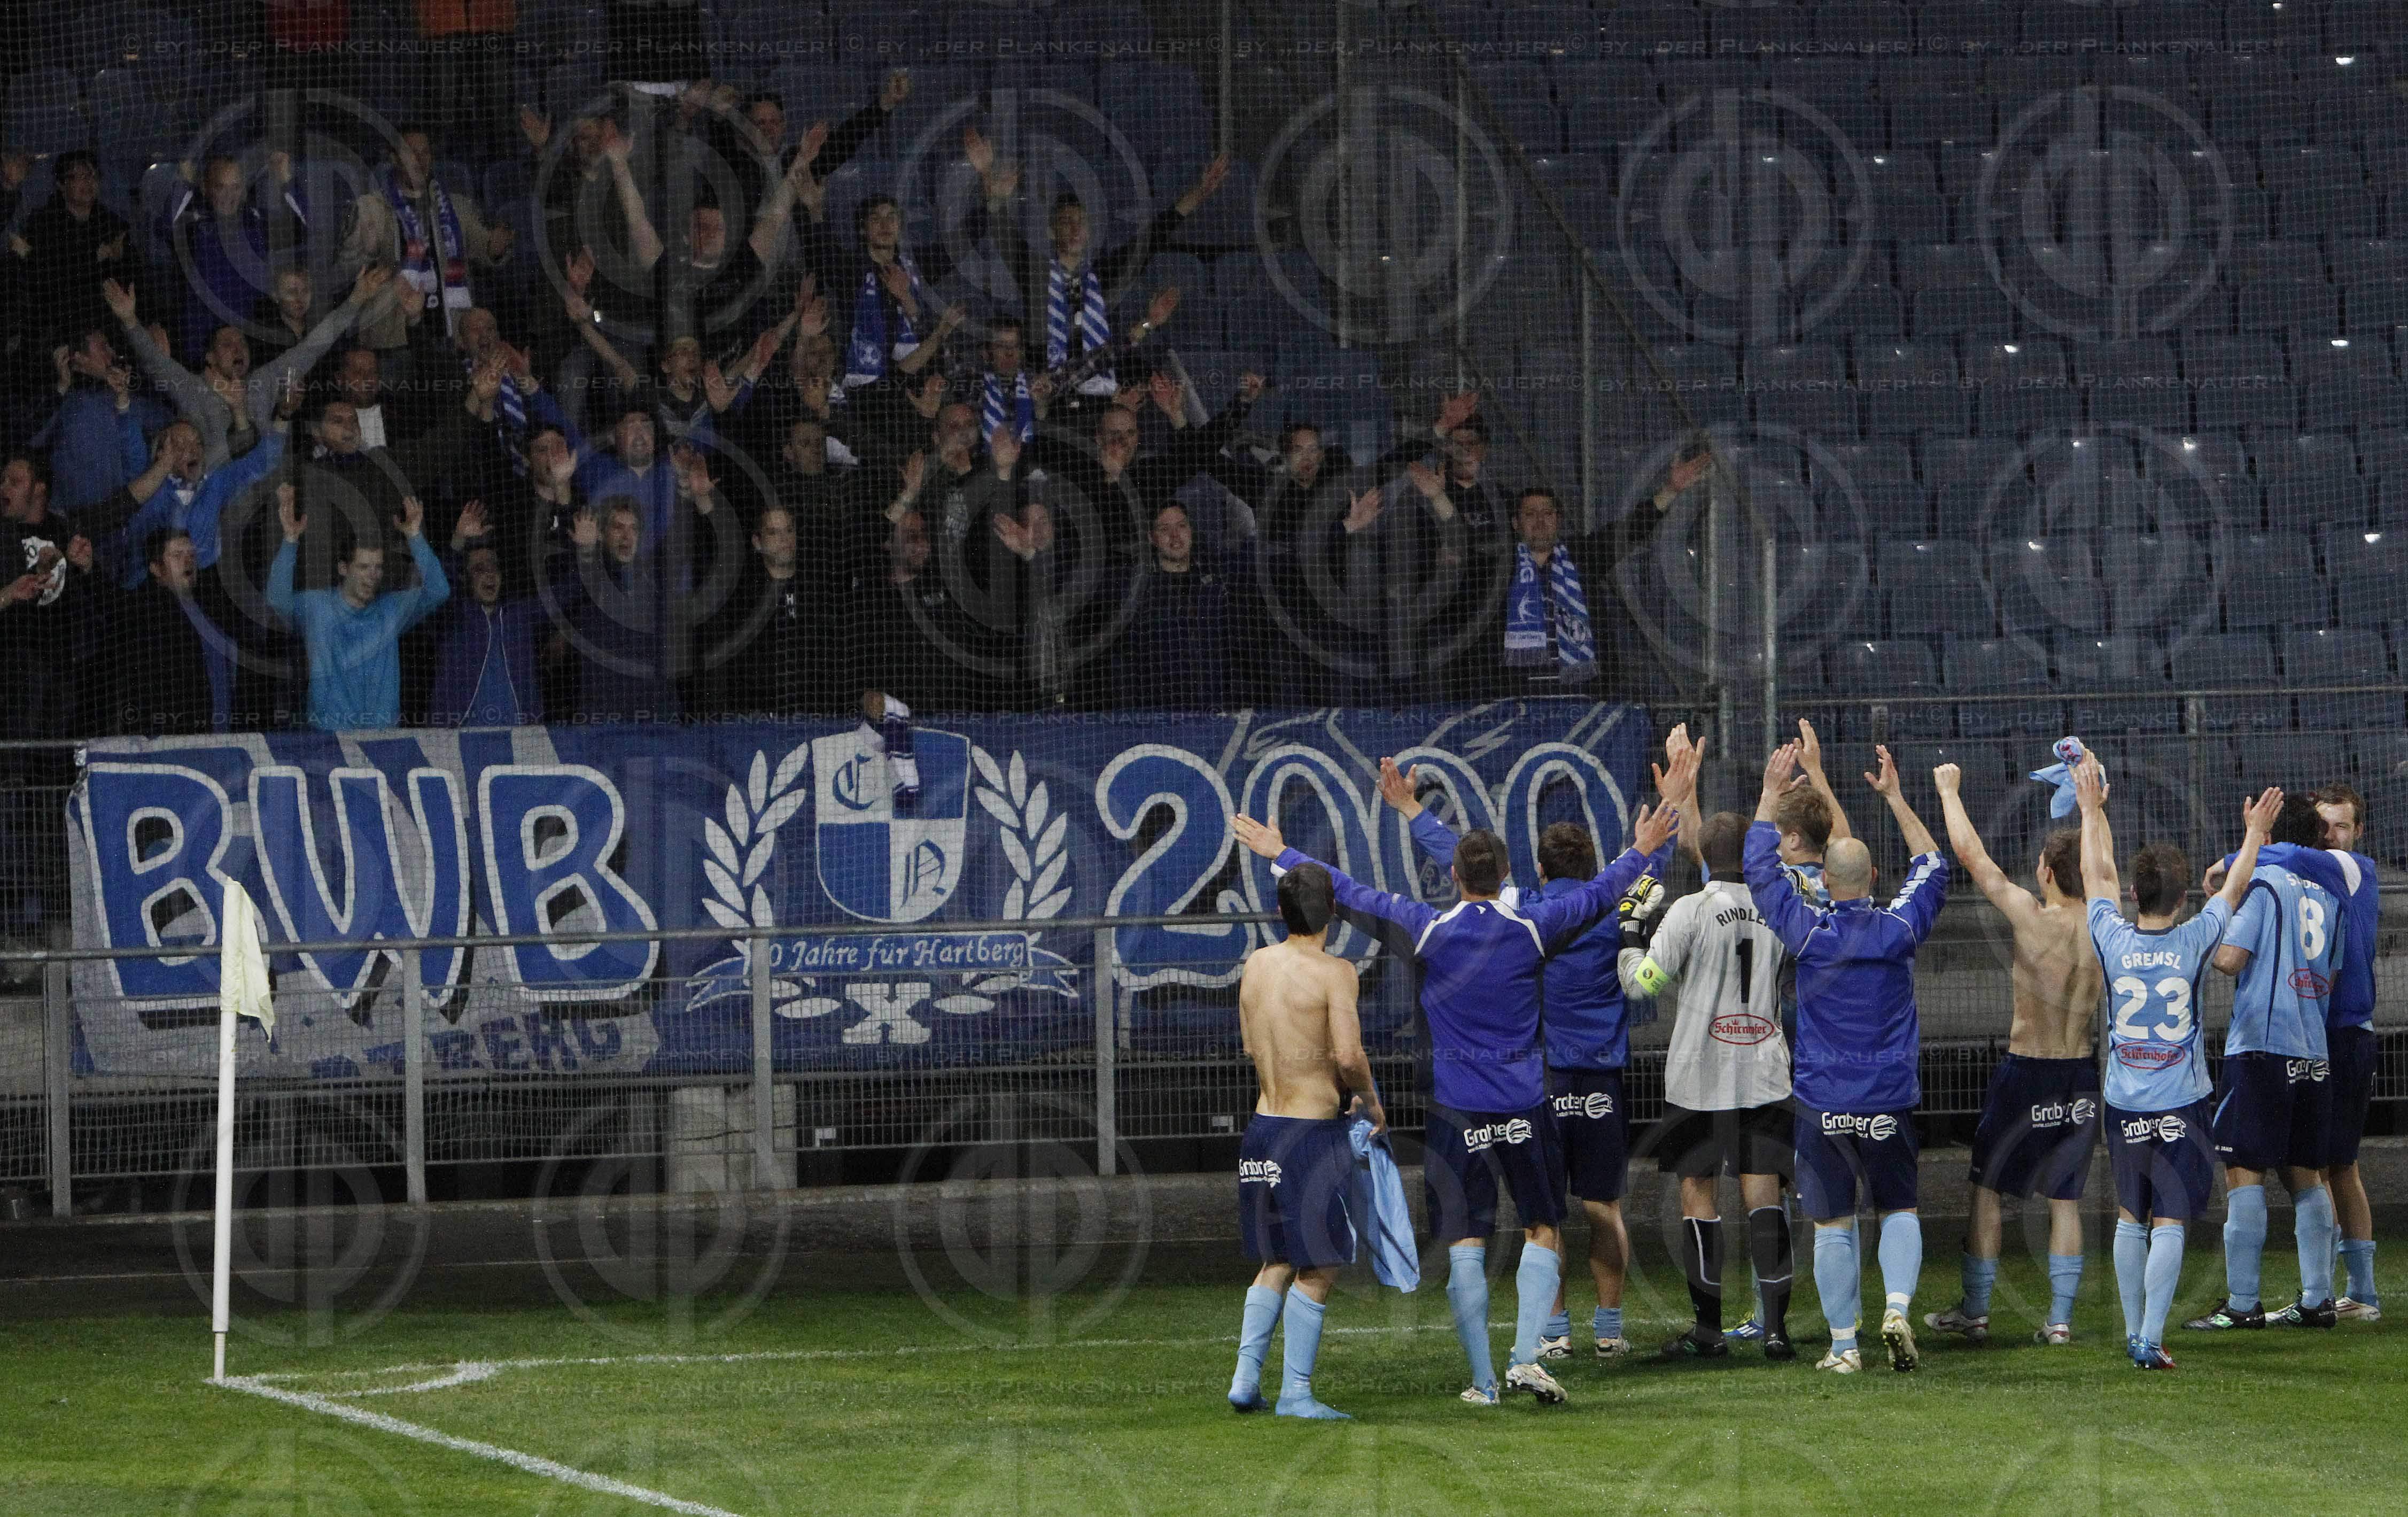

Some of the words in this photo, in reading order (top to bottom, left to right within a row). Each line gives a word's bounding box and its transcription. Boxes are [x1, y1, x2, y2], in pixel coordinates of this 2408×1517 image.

[81, 763, 658, 1011] BWB
[1097, 742, 1628, 990] 2000
[790, 938, 858, 971] Jahre
[860, 938, 910, 971] für
[914, 935, 1025, 968] Hartberg
[2122, 951, 2181, 970] GREMSL
[2299, 895, 2325, 961] 8
[1736, 939, 1753, 1004] 1
[2112, 976, 2192, 1041] 23
[1822, 1112, 1871, 1131] Graber
